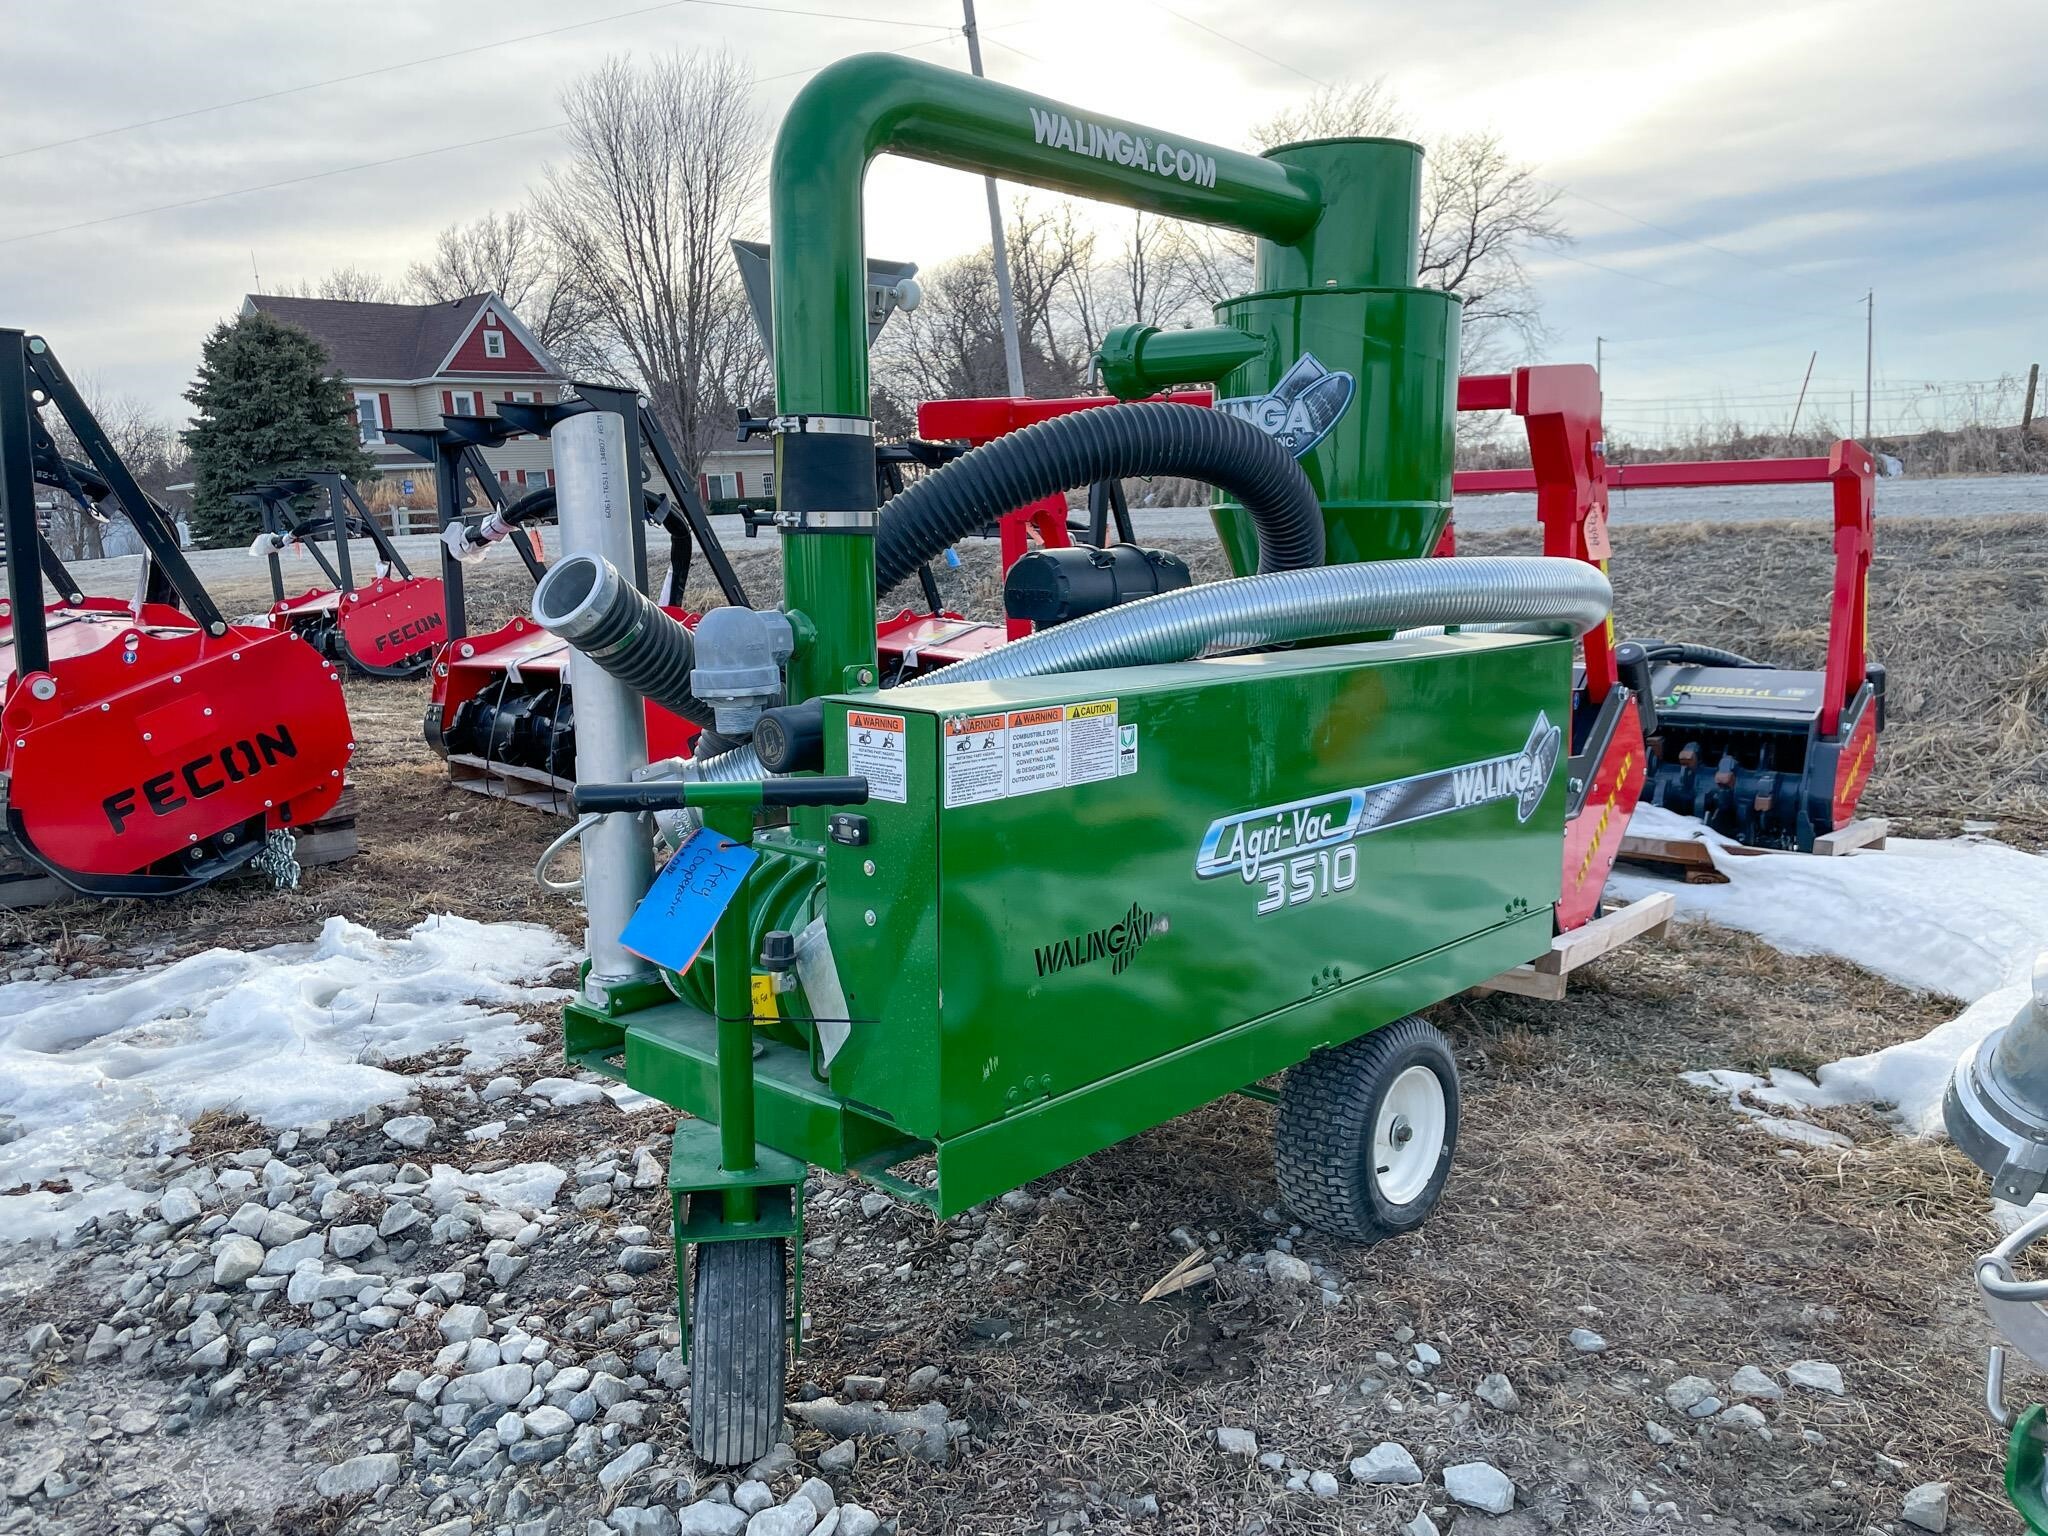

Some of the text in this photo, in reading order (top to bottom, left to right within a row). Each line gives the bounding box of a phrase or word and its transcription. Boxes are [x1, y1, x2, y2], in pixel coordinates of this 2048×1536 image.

[1275, 435, 1298, 448] NC.
[374, 612, 443, 653] FECON
[1080, 703, 1112, 716] CAUTION
[863, 716, 899, 730] WARNING
[1023, 710, 1059, 724] WARNING
[1012, 728, 1059, 741] COMBUSTIBLE DUST
[1012, 741, 1039, 750] EXPLOSION
[1035, 745, 1060, 754] INCLUDING
[1016, 757, 1044, 766] CONVEYING
[1021, 765, 1046, 774] DESIGNED
[102, 723, 298, 836] FECON
[1011, 774, 1036, 784] OUTDOOR
[1046, 770, 1058, 778] ONLY
[1452, 753, 1544, 808] WALINGA
[1224, 807, 1337, 883] Agri-Vac
[691, 862, 737, 897] Key
[1256, 843, 1358, 917] 3510
[1034, 921, 1144, 977] WALINGA
